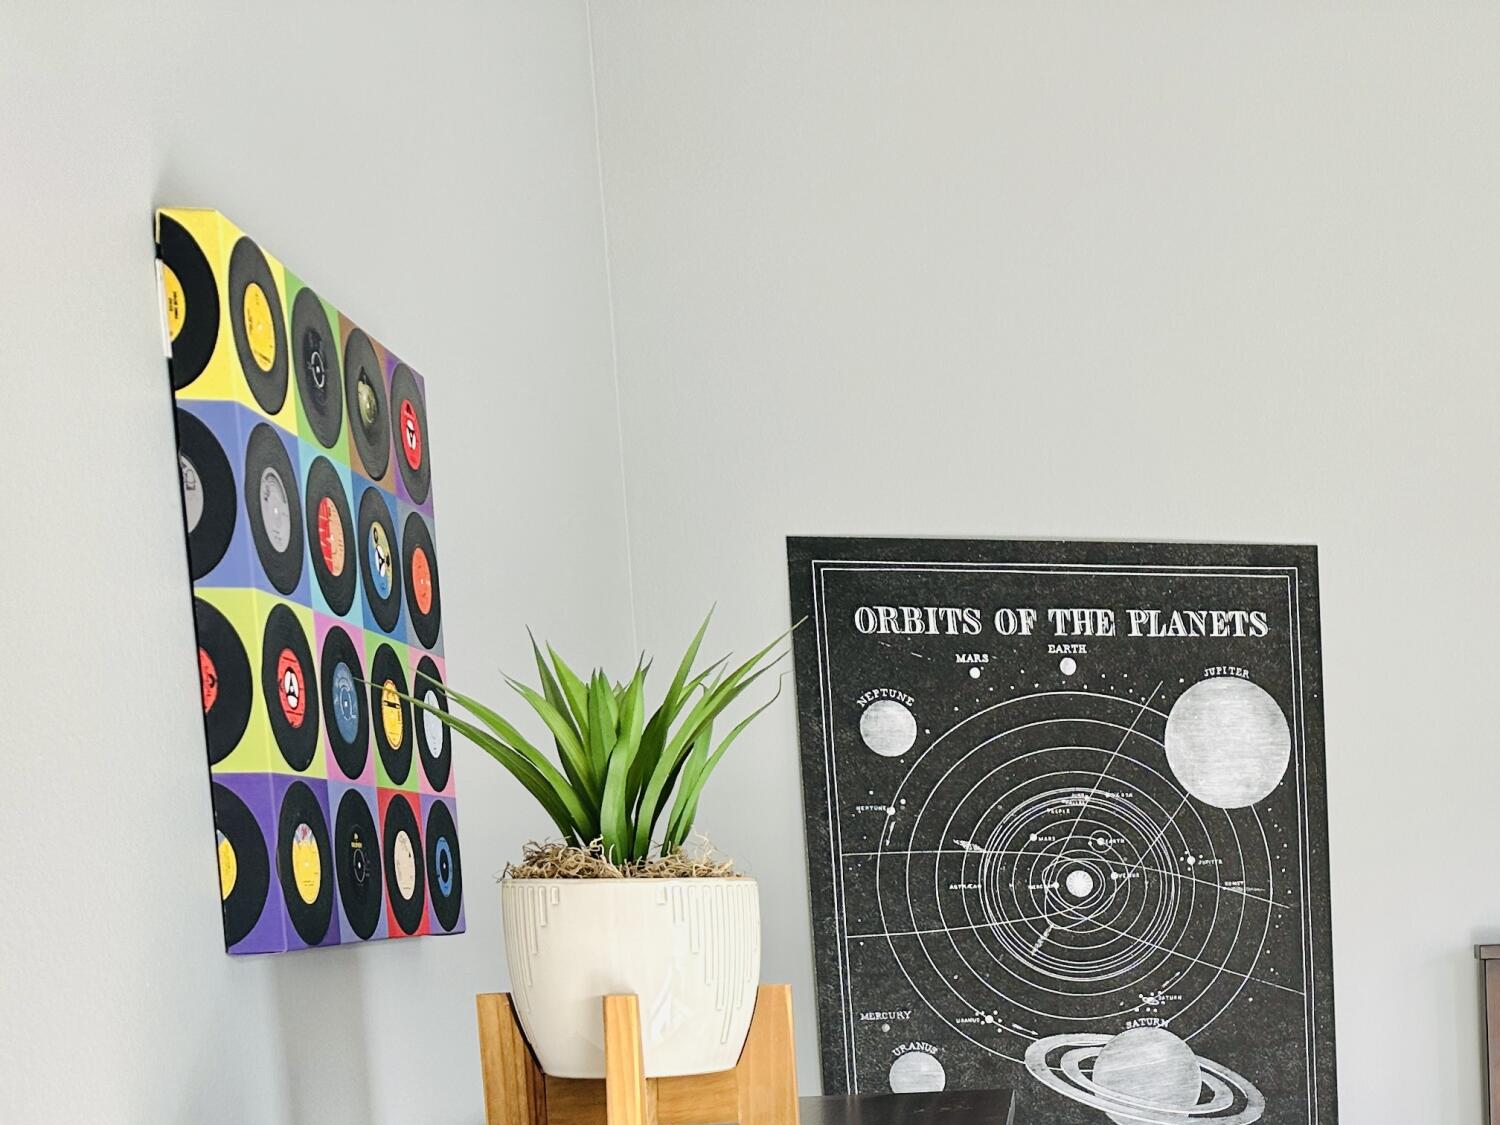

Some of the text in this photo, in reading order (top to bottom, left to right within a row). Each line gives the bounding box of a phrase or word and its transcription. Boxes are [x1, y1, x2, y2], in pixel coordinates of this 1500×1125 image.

[854, 606, 1269, 637] ORBITS OF THE PLANETS
[1048, 644, 1088, 655] EARTH
[956, 653, 989, 664] MARS
[1203, 666, 1251, 679] JUPITER
[856, 688, 916, 707] NEPTUNE
[860, 1010, 912, 1021] MERCURY
[1126, 1017, 1170, 1029] SATURN
[892, 1042, 938, 1056] URANUS
